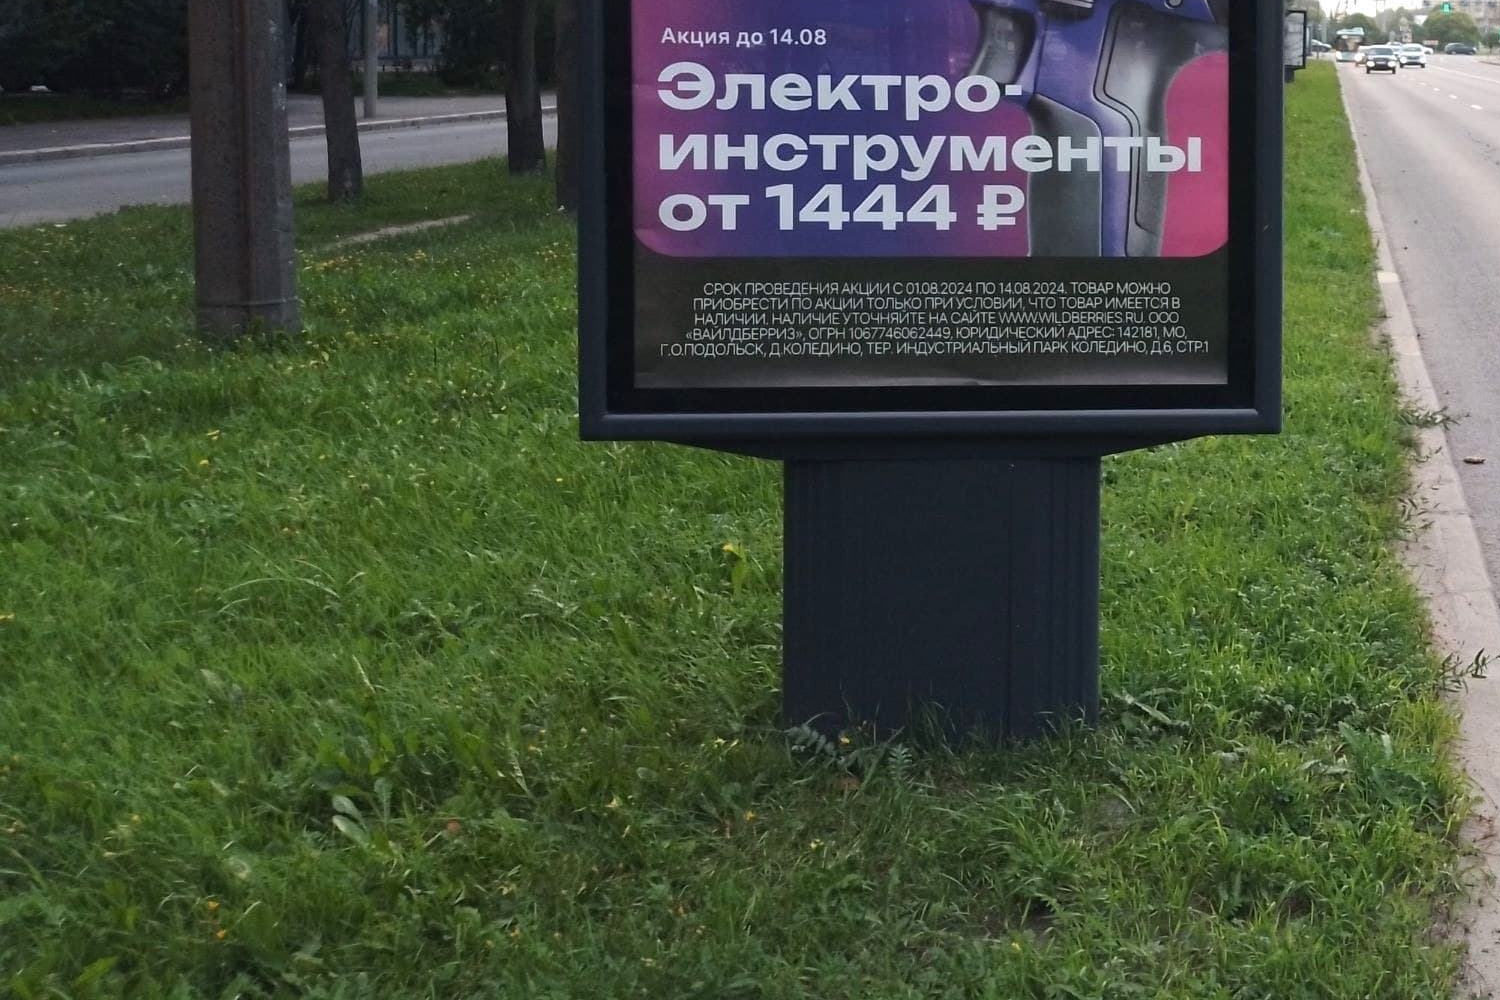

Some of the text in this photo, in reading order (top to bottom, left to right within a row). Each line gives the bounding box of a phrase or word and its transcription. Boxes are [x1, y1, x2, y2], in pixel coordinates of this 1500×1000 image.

[661, 27, 827, 48] Акция до 14.08
[658, 62, 1023, 121] Электро-
[659, 133, 1202, 182] инструменты
[658, 194, 749, 231] от
[765, 185, 957, 231] 1444
[703, 282, 1172, 296] СРОК ПРОВЕДЕНИЯ АКЦИИ С 01.08.2024 ПО 14.08.2024. ТОВАР МОЖНО
[693, 297, 1181, 311] ПРИОБРЕСТИ ПО АКЦИИ ТОЛЬКО ПРИ УСЛОВИИ, ЧТО ТОВАР ИМЕЕТСЯ В
[694, 312, 769, 326] НАЛИЧИИ.
[771, 312, 841, 326] НАЛИЧИЕ
[843, 312, 927, 326] УТОЧНЯЙТЕ
[928, 312, 948, 326] НА
[950, 312, 997, 326] САЙТЕ
[1147, 312, 1180, 326] ООО
[685, 327, 1188, 341] «ВАЙЛДБЕРРИЗ», ОГРН 1067746062449, ЮРИДИЧЕСКИЙ АДРЕС: 142181, МО,
[867, 342, 894, 356] ТЕР.
[896, 342, 1031, 356] ИНДУСТРИАЛЬНЫЙ
[1033, 342, 1069, 356] ПАРК
[1071, 342, 1149, 356] КОЛЕДИНО,
